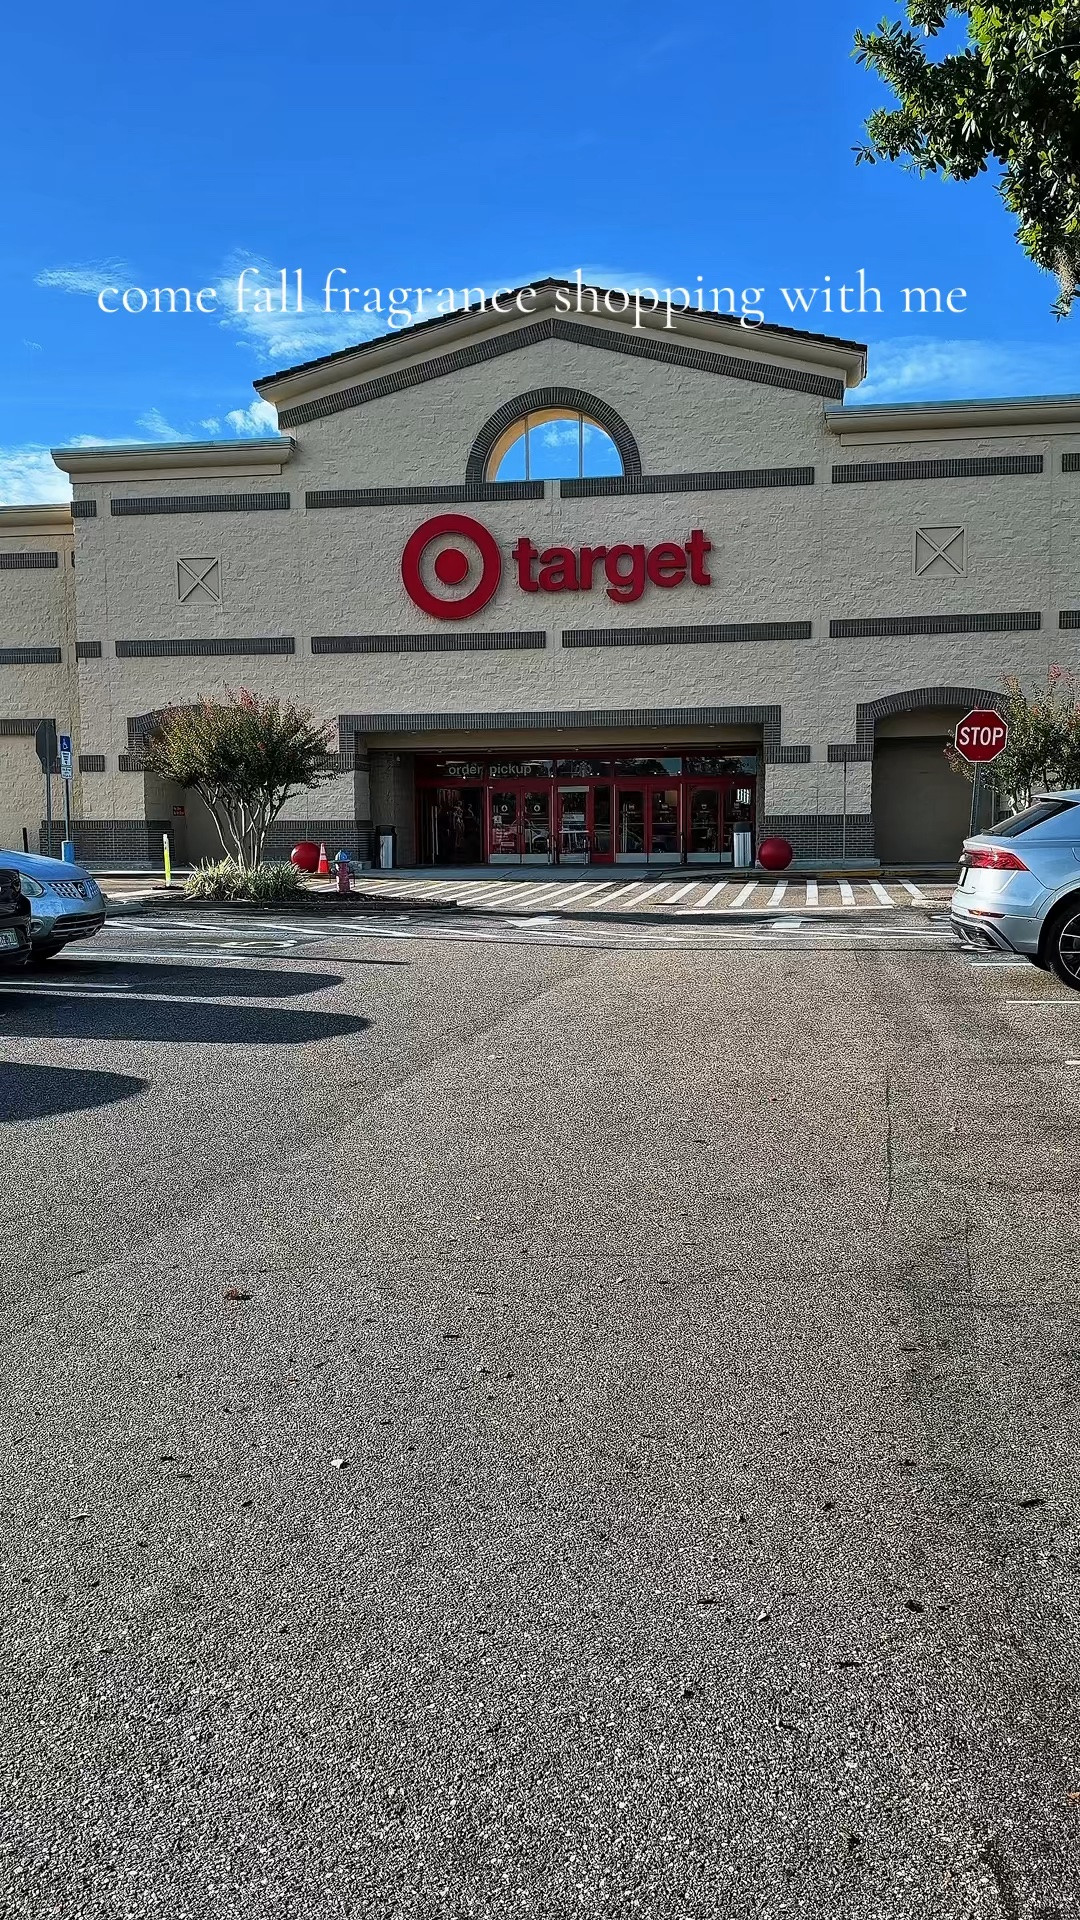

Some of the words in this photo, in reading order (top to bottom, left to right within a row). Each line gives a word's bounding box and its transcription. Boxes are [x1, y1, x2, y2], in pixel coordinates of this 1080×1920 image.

[512, 529, 712, 604] target
[959, 726, 1004, 746] STOP
[448, 763, 483, 776] order
[489, 762, 532, 777] pickup
